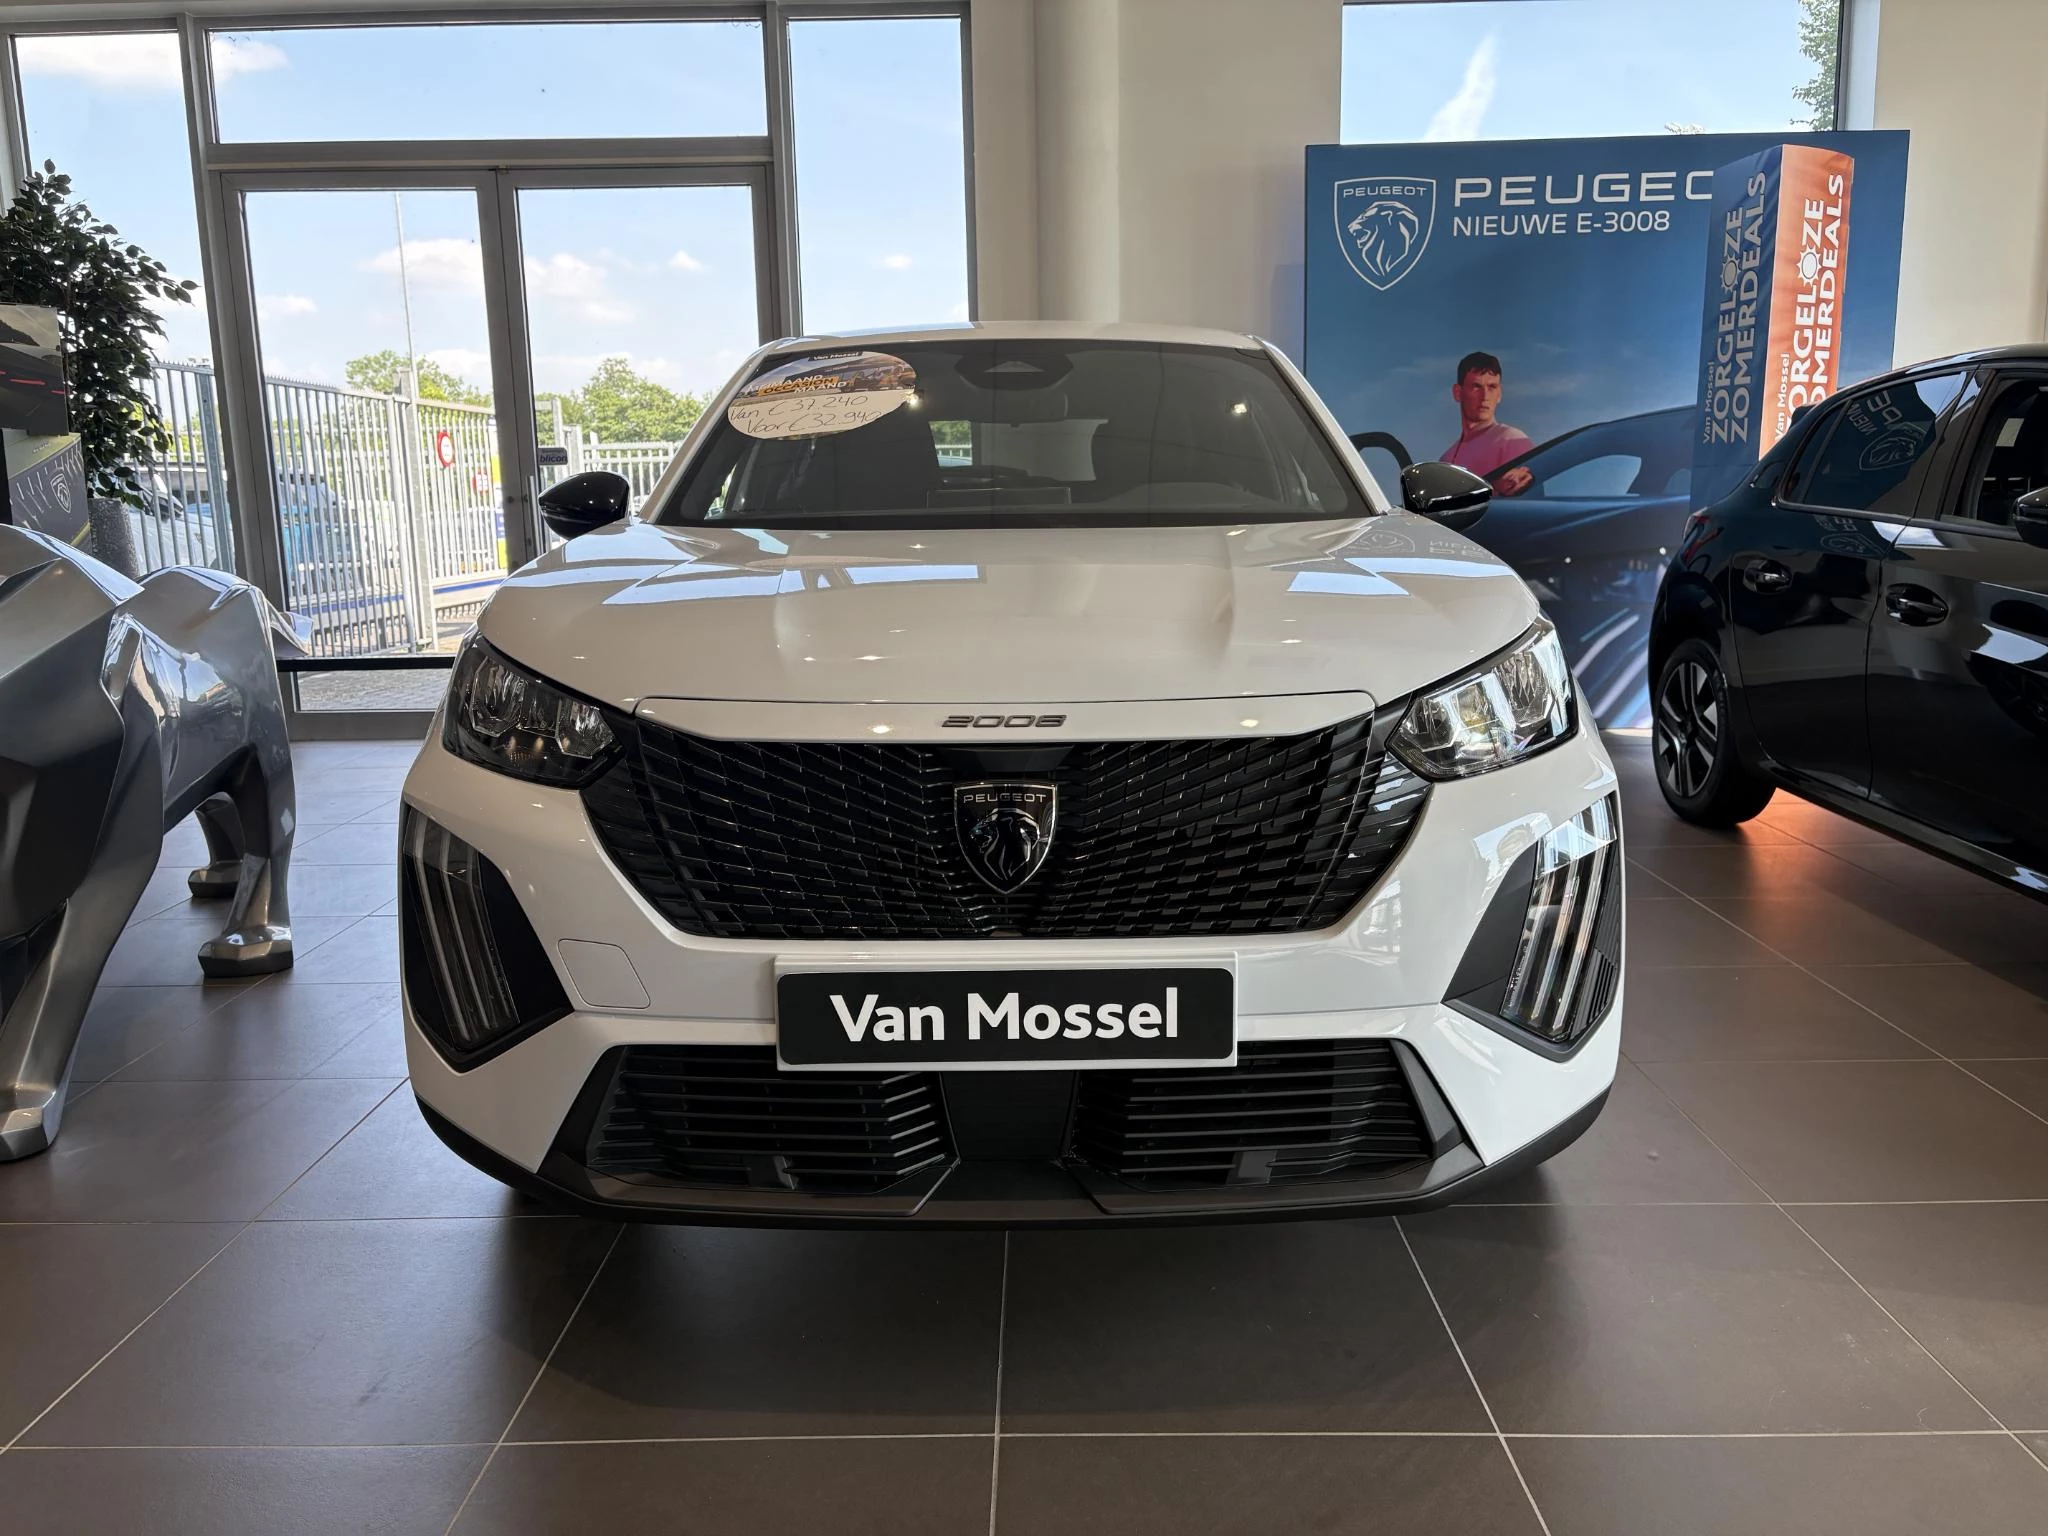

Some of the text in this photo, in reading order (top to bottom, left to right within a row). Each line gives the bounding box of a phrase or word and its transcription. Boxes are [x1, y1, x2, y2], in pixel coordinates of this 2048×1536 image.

[1343, 186, 1428, 198] PEUGEOT
[1453, 210, 1670, 237] NIEUWE E-3008
[1730, 171, 1766, 444] ZOMERDEALS
[1784, 198, 1824, 432] ORGELOZE
[1711, 206, 1743, 444] ZORGELOZE
[763, 378, 834, 394] OCCASION
[794, 381, 847, 394] MAAND
[1702, 361, 1715, 444] Van Mossel
[1775, 353, 1790, 441] Van Mossel
[730, 408, 760, 420] Van
[747, 418, 787, 434] Voor
[941, 715, 1067, 728] 2008
[963, 793, 1047, 803] PEUGEOT
[829, 986, 1178, 1042] Van Mossel
